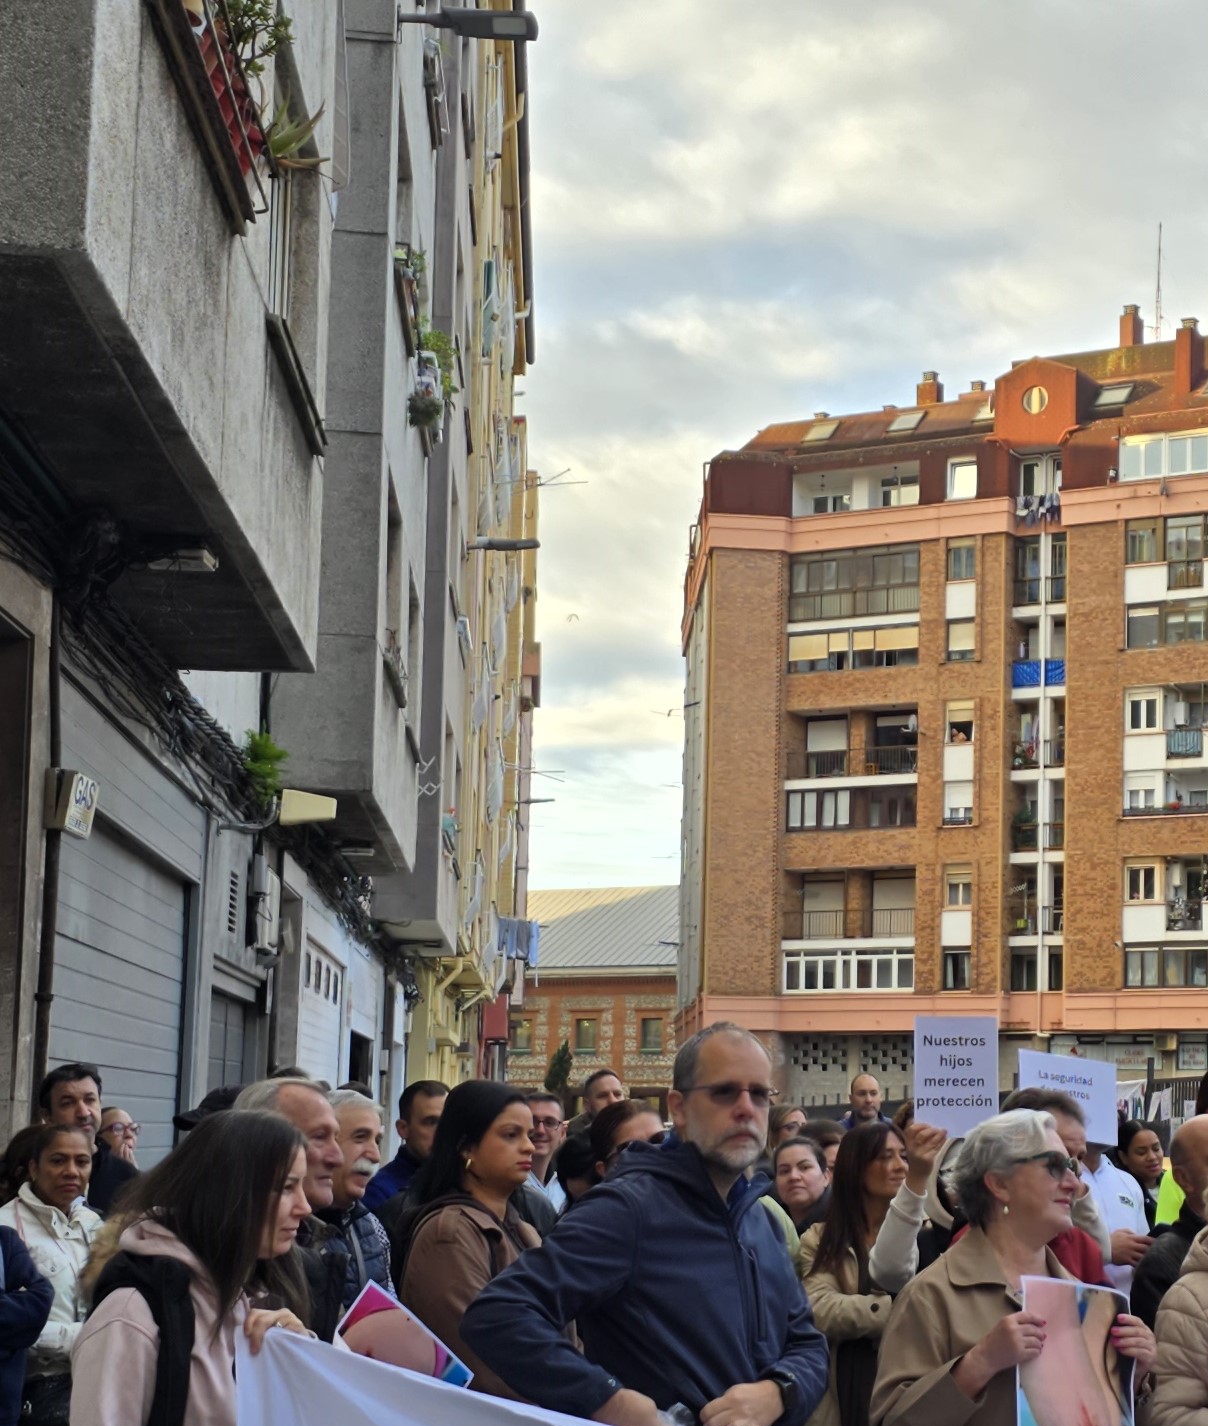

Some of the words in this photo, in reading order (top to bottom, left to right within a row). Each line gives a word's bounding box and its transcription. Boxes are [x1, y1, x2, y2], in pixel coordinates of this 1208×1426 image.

[74, 775, 96, 811] GAS
[923, 1035, 986, 1046] Nuestros
[940, 1054, 973, 1070] hijos
[924, 1077, 985, 1087] merecen
[1038, 1070, 1049, 1079] La
[1050, 1073, 1093, 1086] seguridad
[917, 1095, 993, 1110] protección
